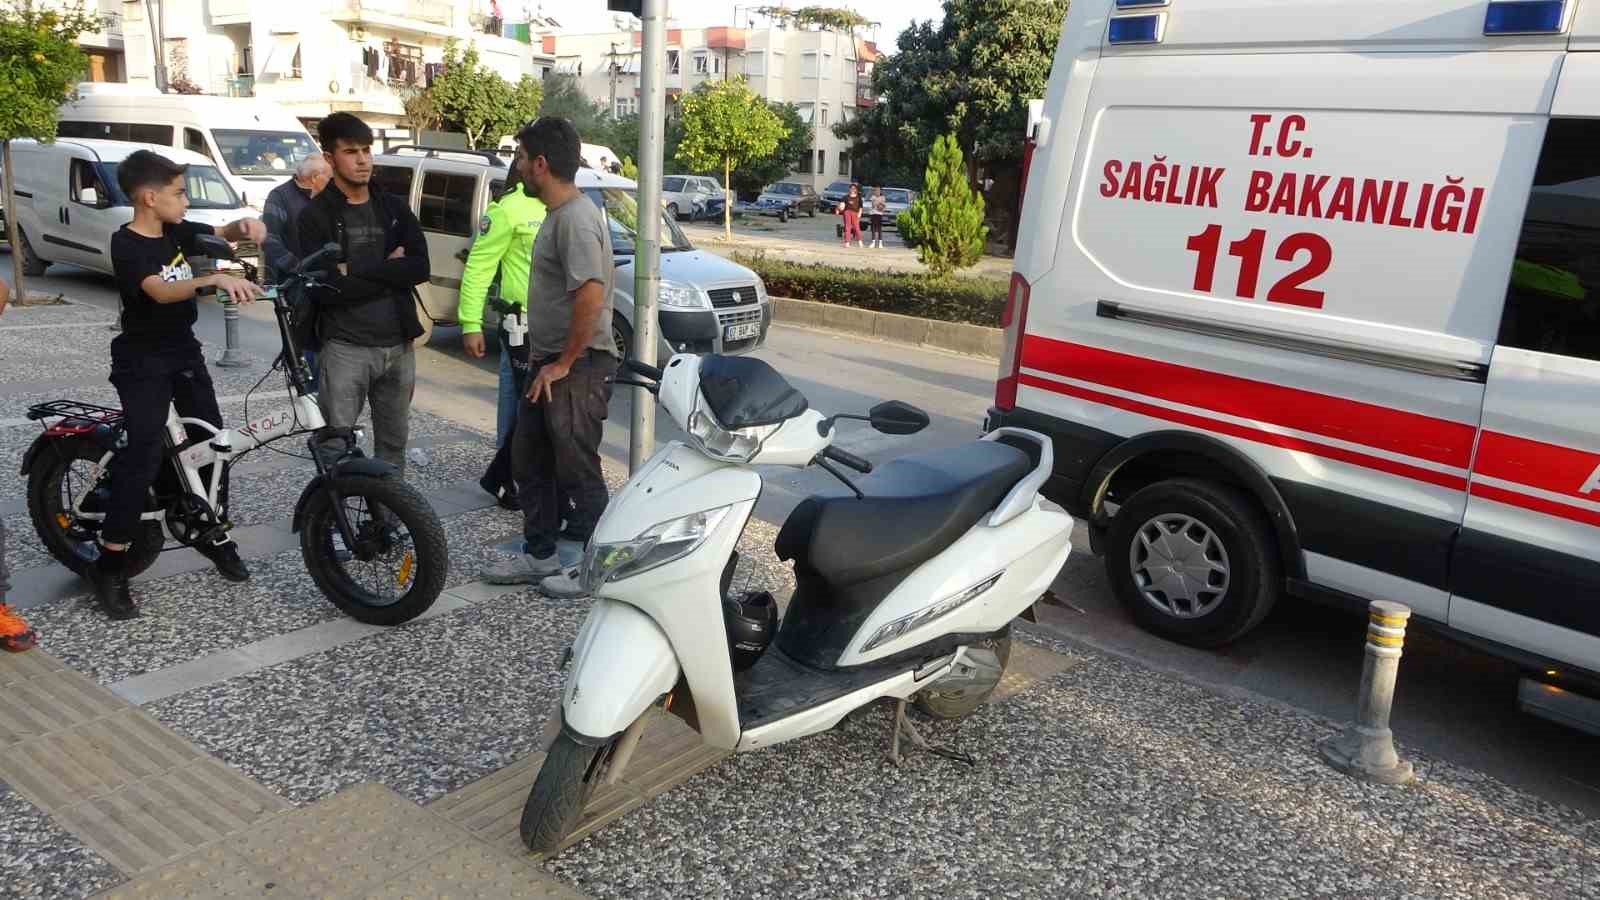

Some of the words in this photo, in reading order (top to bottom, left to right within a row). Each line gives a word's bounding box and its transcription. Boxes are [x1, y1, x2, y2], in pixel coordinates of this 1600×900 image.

[1248, 114, 1312, 158] T.C.
[1100, 154, 1226, 209] SAĞLIK
[1244, 170, 1485, 235] BAKANLIĞI
[1186, 223, 1333, 309] 112
